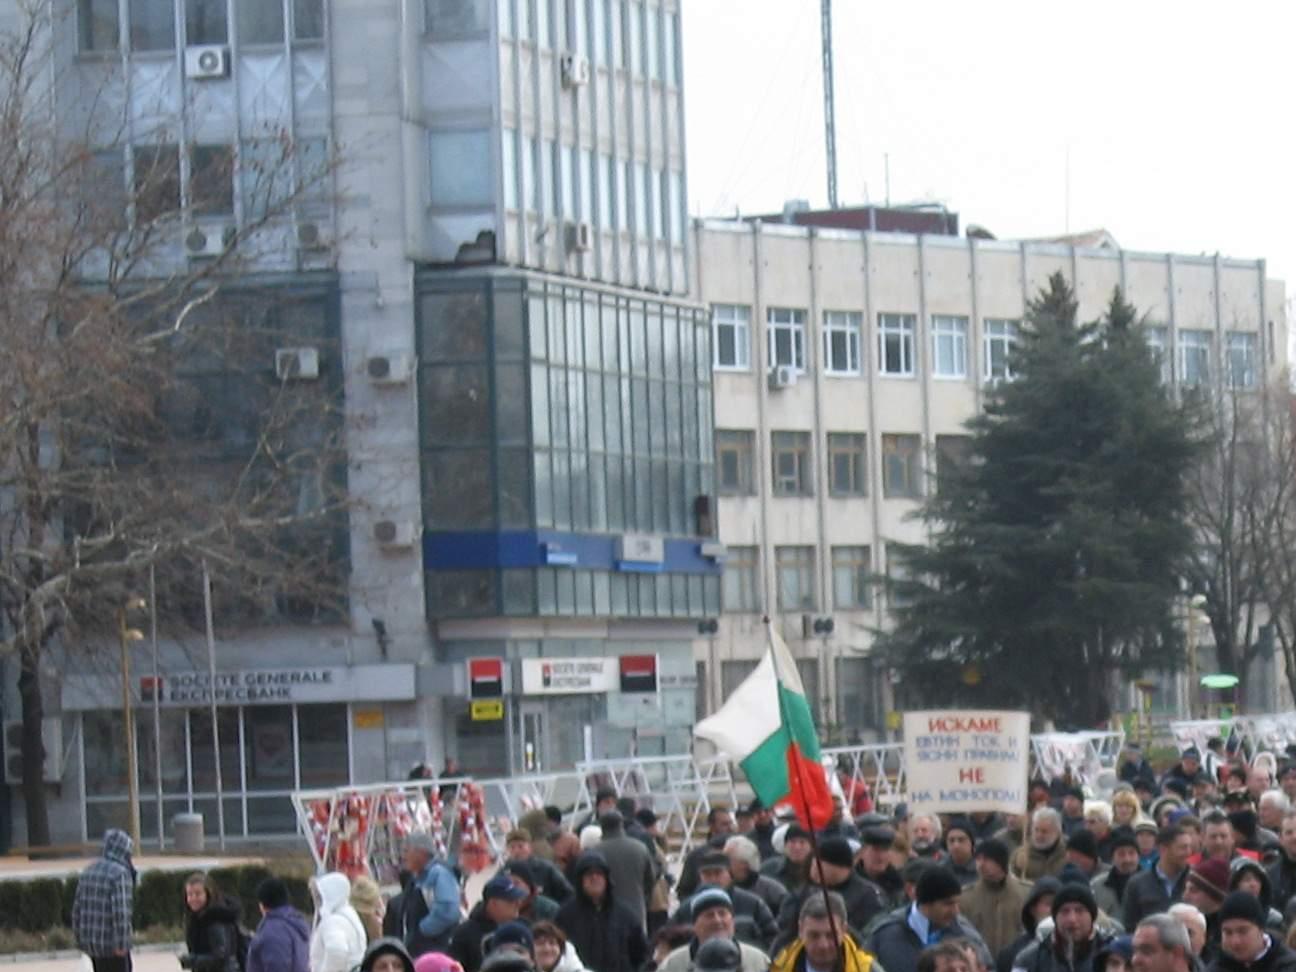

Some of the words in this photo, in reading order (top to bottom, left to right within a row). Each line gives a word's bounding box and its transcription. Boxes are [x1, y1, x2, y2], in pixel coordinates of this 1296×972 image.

[245, 669, 333, 686] GENERALE
[928, 717, 1003, 734] ИСКАМЕ
[959, 767, 986, 785] НЕ
[911, 792, 933, 804] НА
